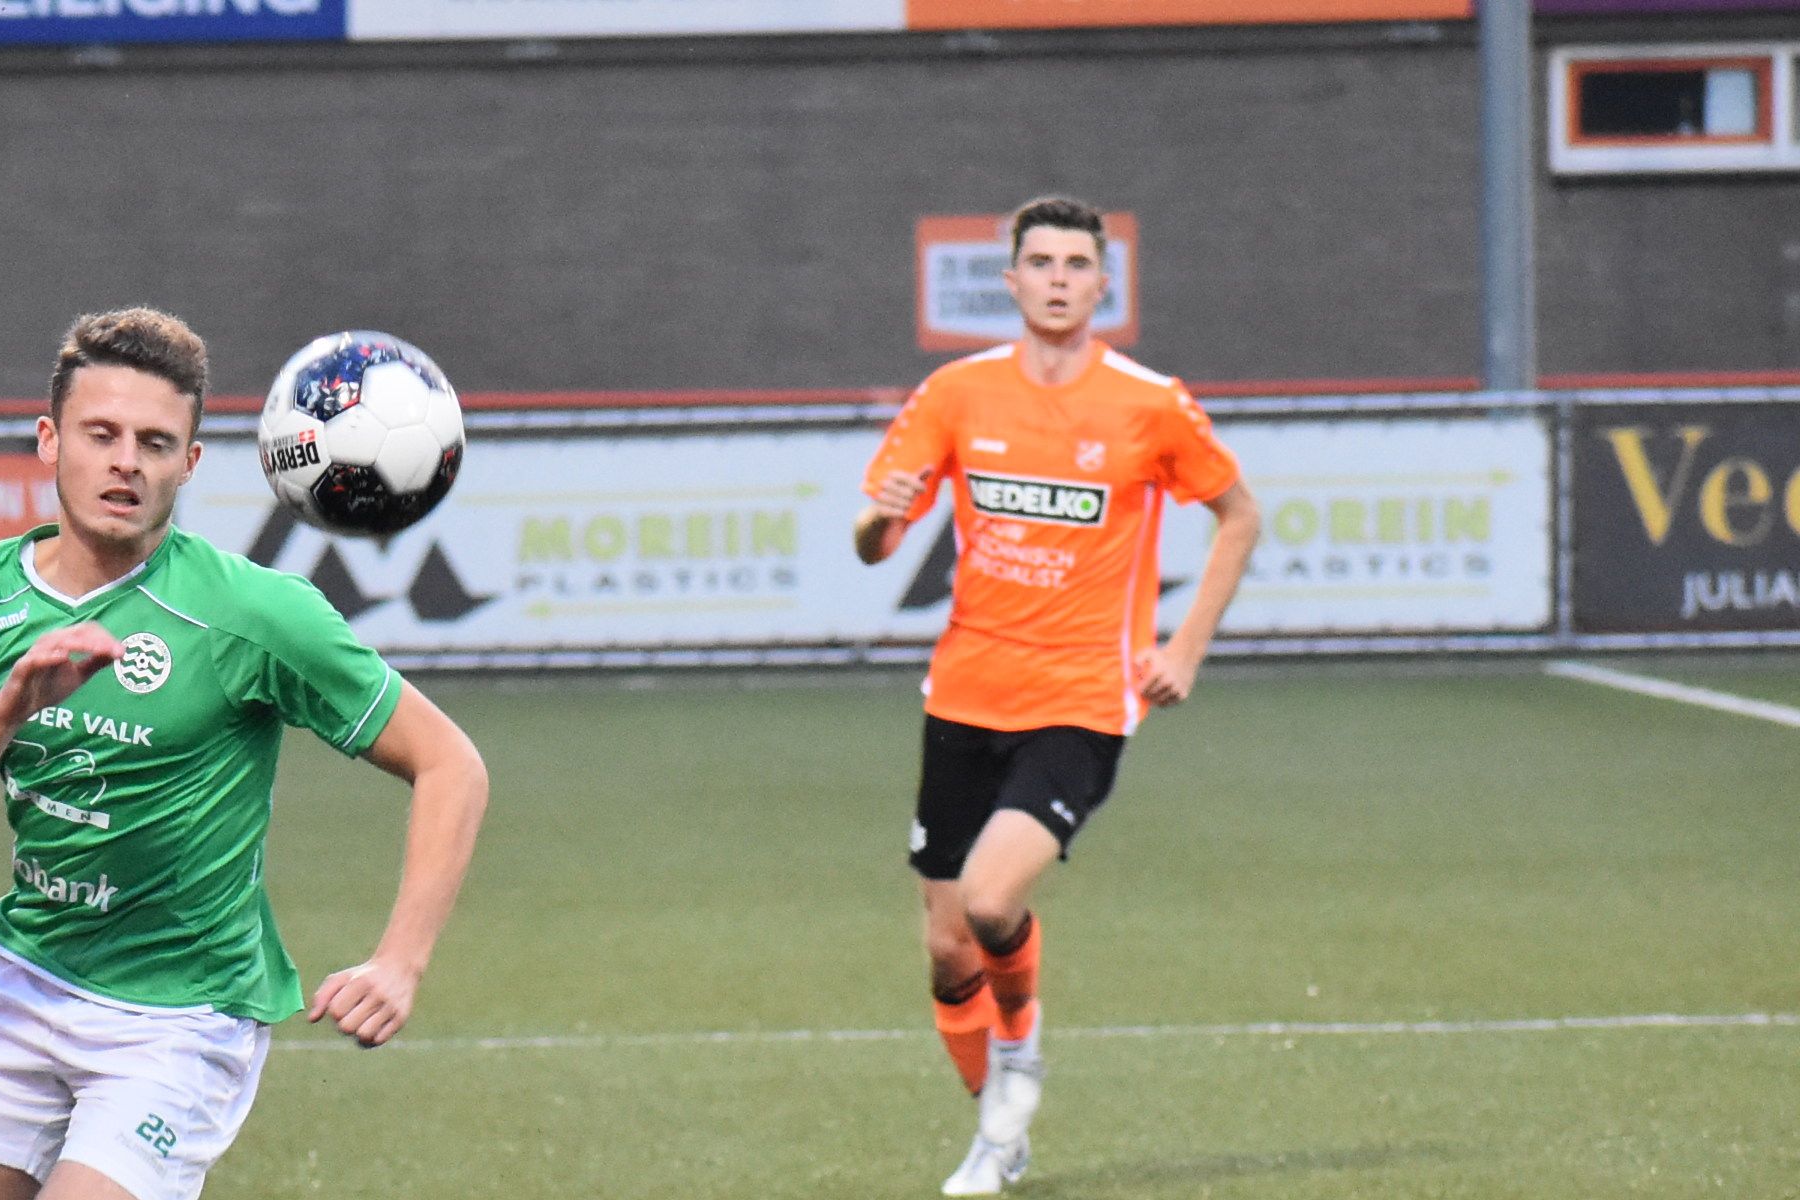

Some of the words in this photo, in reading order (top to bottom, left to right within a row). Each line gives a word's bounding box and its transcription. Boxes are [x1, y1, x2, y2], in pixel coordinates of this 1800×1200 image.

[1602, 424, 1800, 546] Ve
[518, 511, 795, 562] MOREIN
[514, 567, 799, 597] PLASTICS
[83, 712, 154, 747] VALK
[136, 1113, 177, 1159] 22
